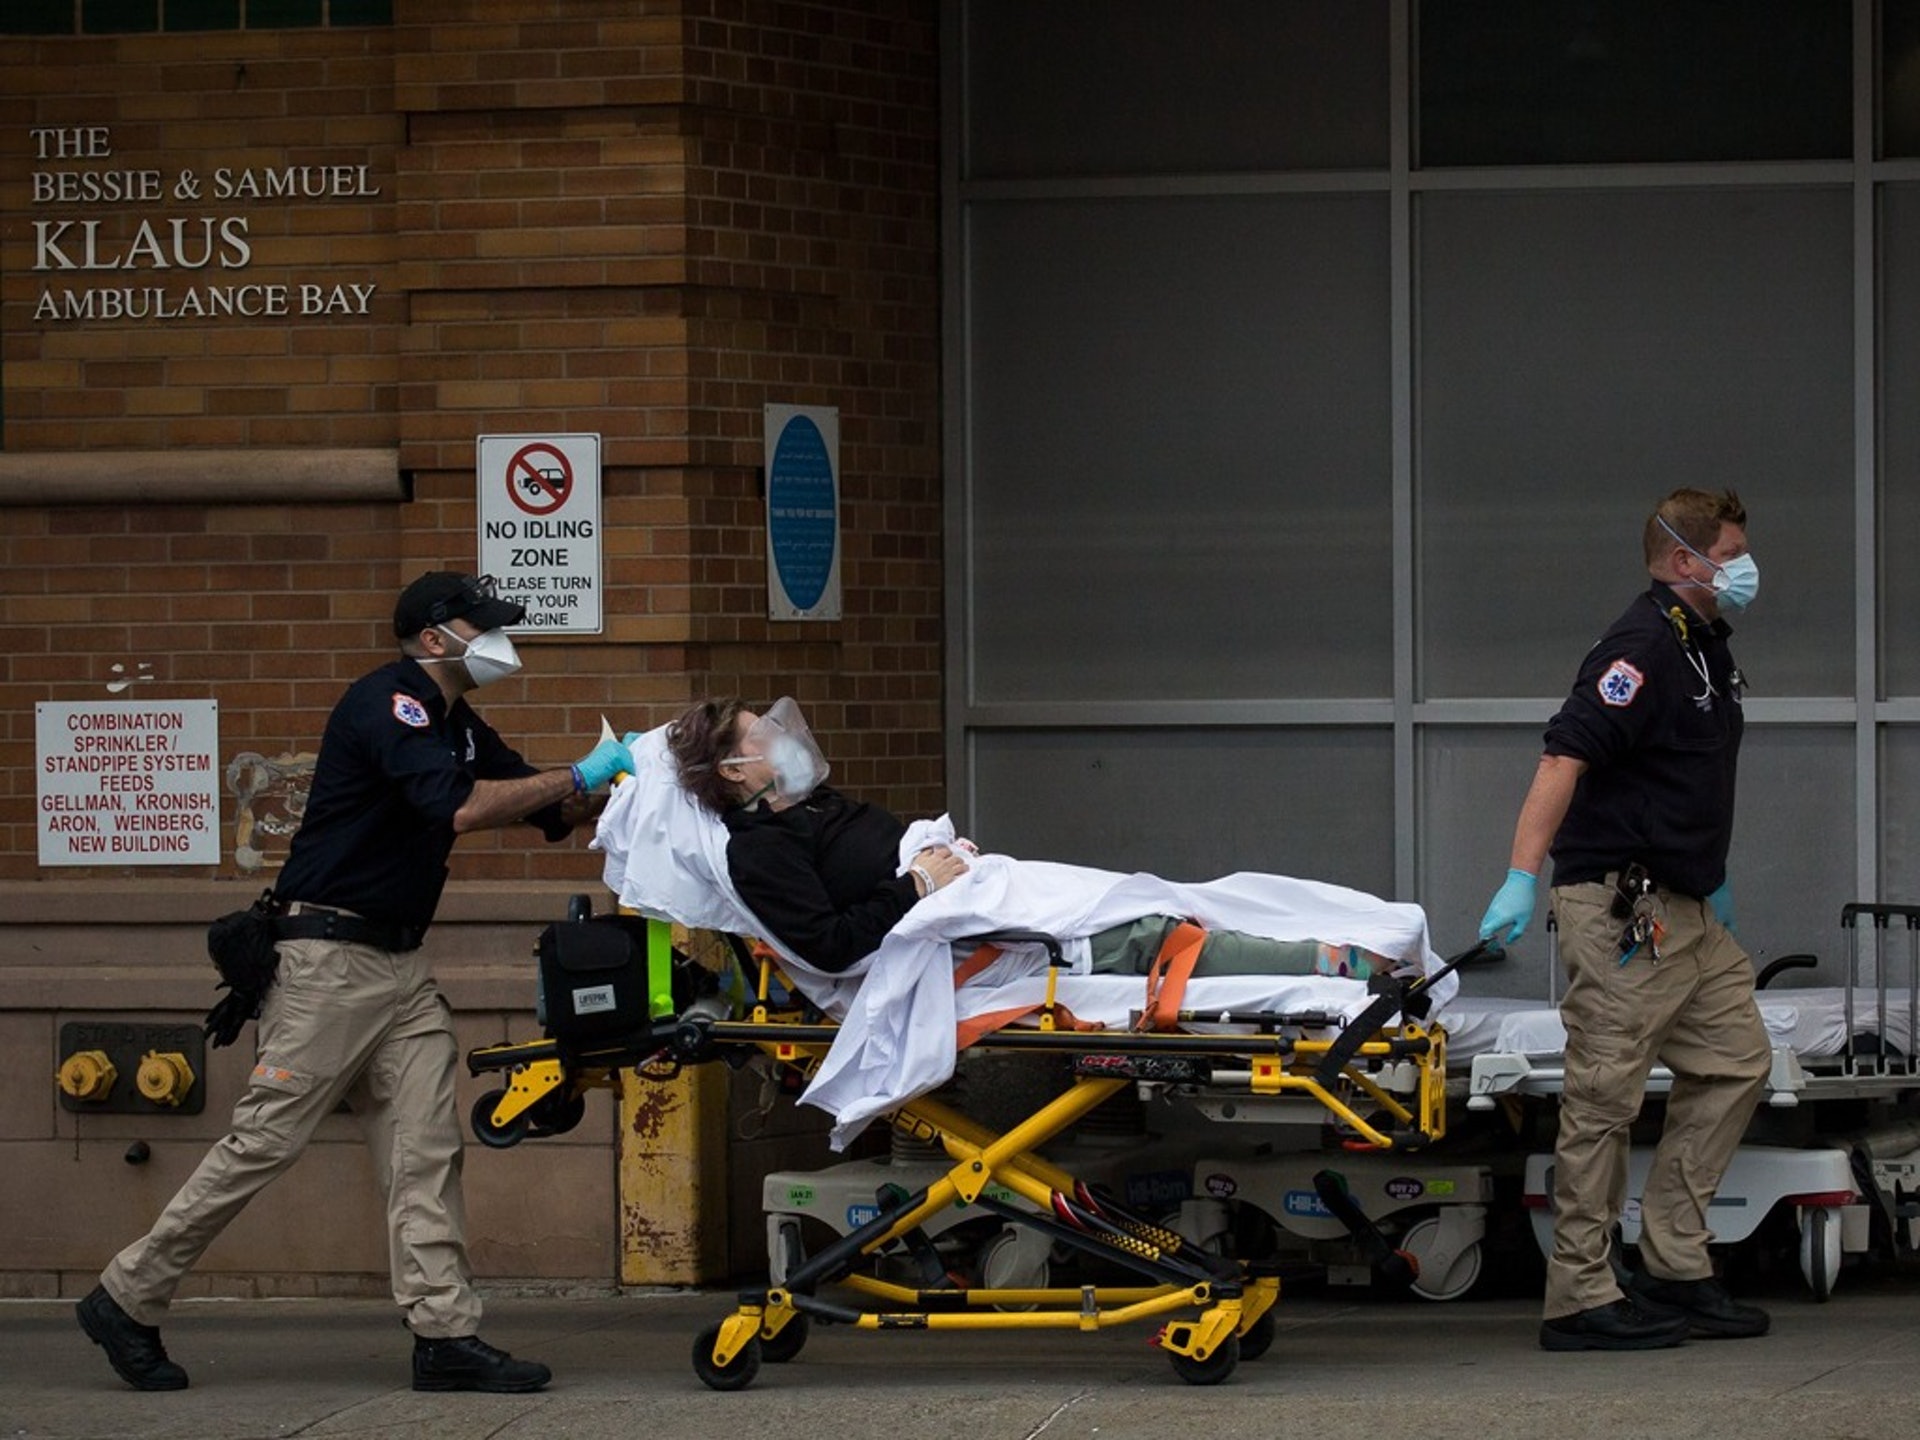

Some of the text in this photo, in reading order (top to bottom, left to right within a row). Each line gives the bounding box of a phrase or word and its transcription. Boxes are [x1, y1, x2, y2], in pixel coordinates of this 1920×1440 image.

[30, 127, 111, 158] THE
[32, 164, 380, 202] BESSIE & SAMUEL
[31, 216, 251, 271] KLAUS
[33, 283, 376, 320] AMBULANCE BAY
[486, 520, 593, 539] NO IDLING
[510, 549, 569, 567] ZONE
[551, 577, 592, 590] TURN
[536, 594, 579, 608] YOUR
[518, 613, 569, 626] NGINE
[67, 713, 183, 731] COMBINATION
[74, 735, 178, 752] SPRINKLER /
[45, 755, 210, 773] STANDPIPE SYSTEM
[100, 775, 154, 792] FEEDS
[41, 793, 215, 812] GELLMAN, KRONISH,
[48, 814, 209, 833] ARON, WEINBERG,
[68, 835, 190, 852] NEW BUILDING
